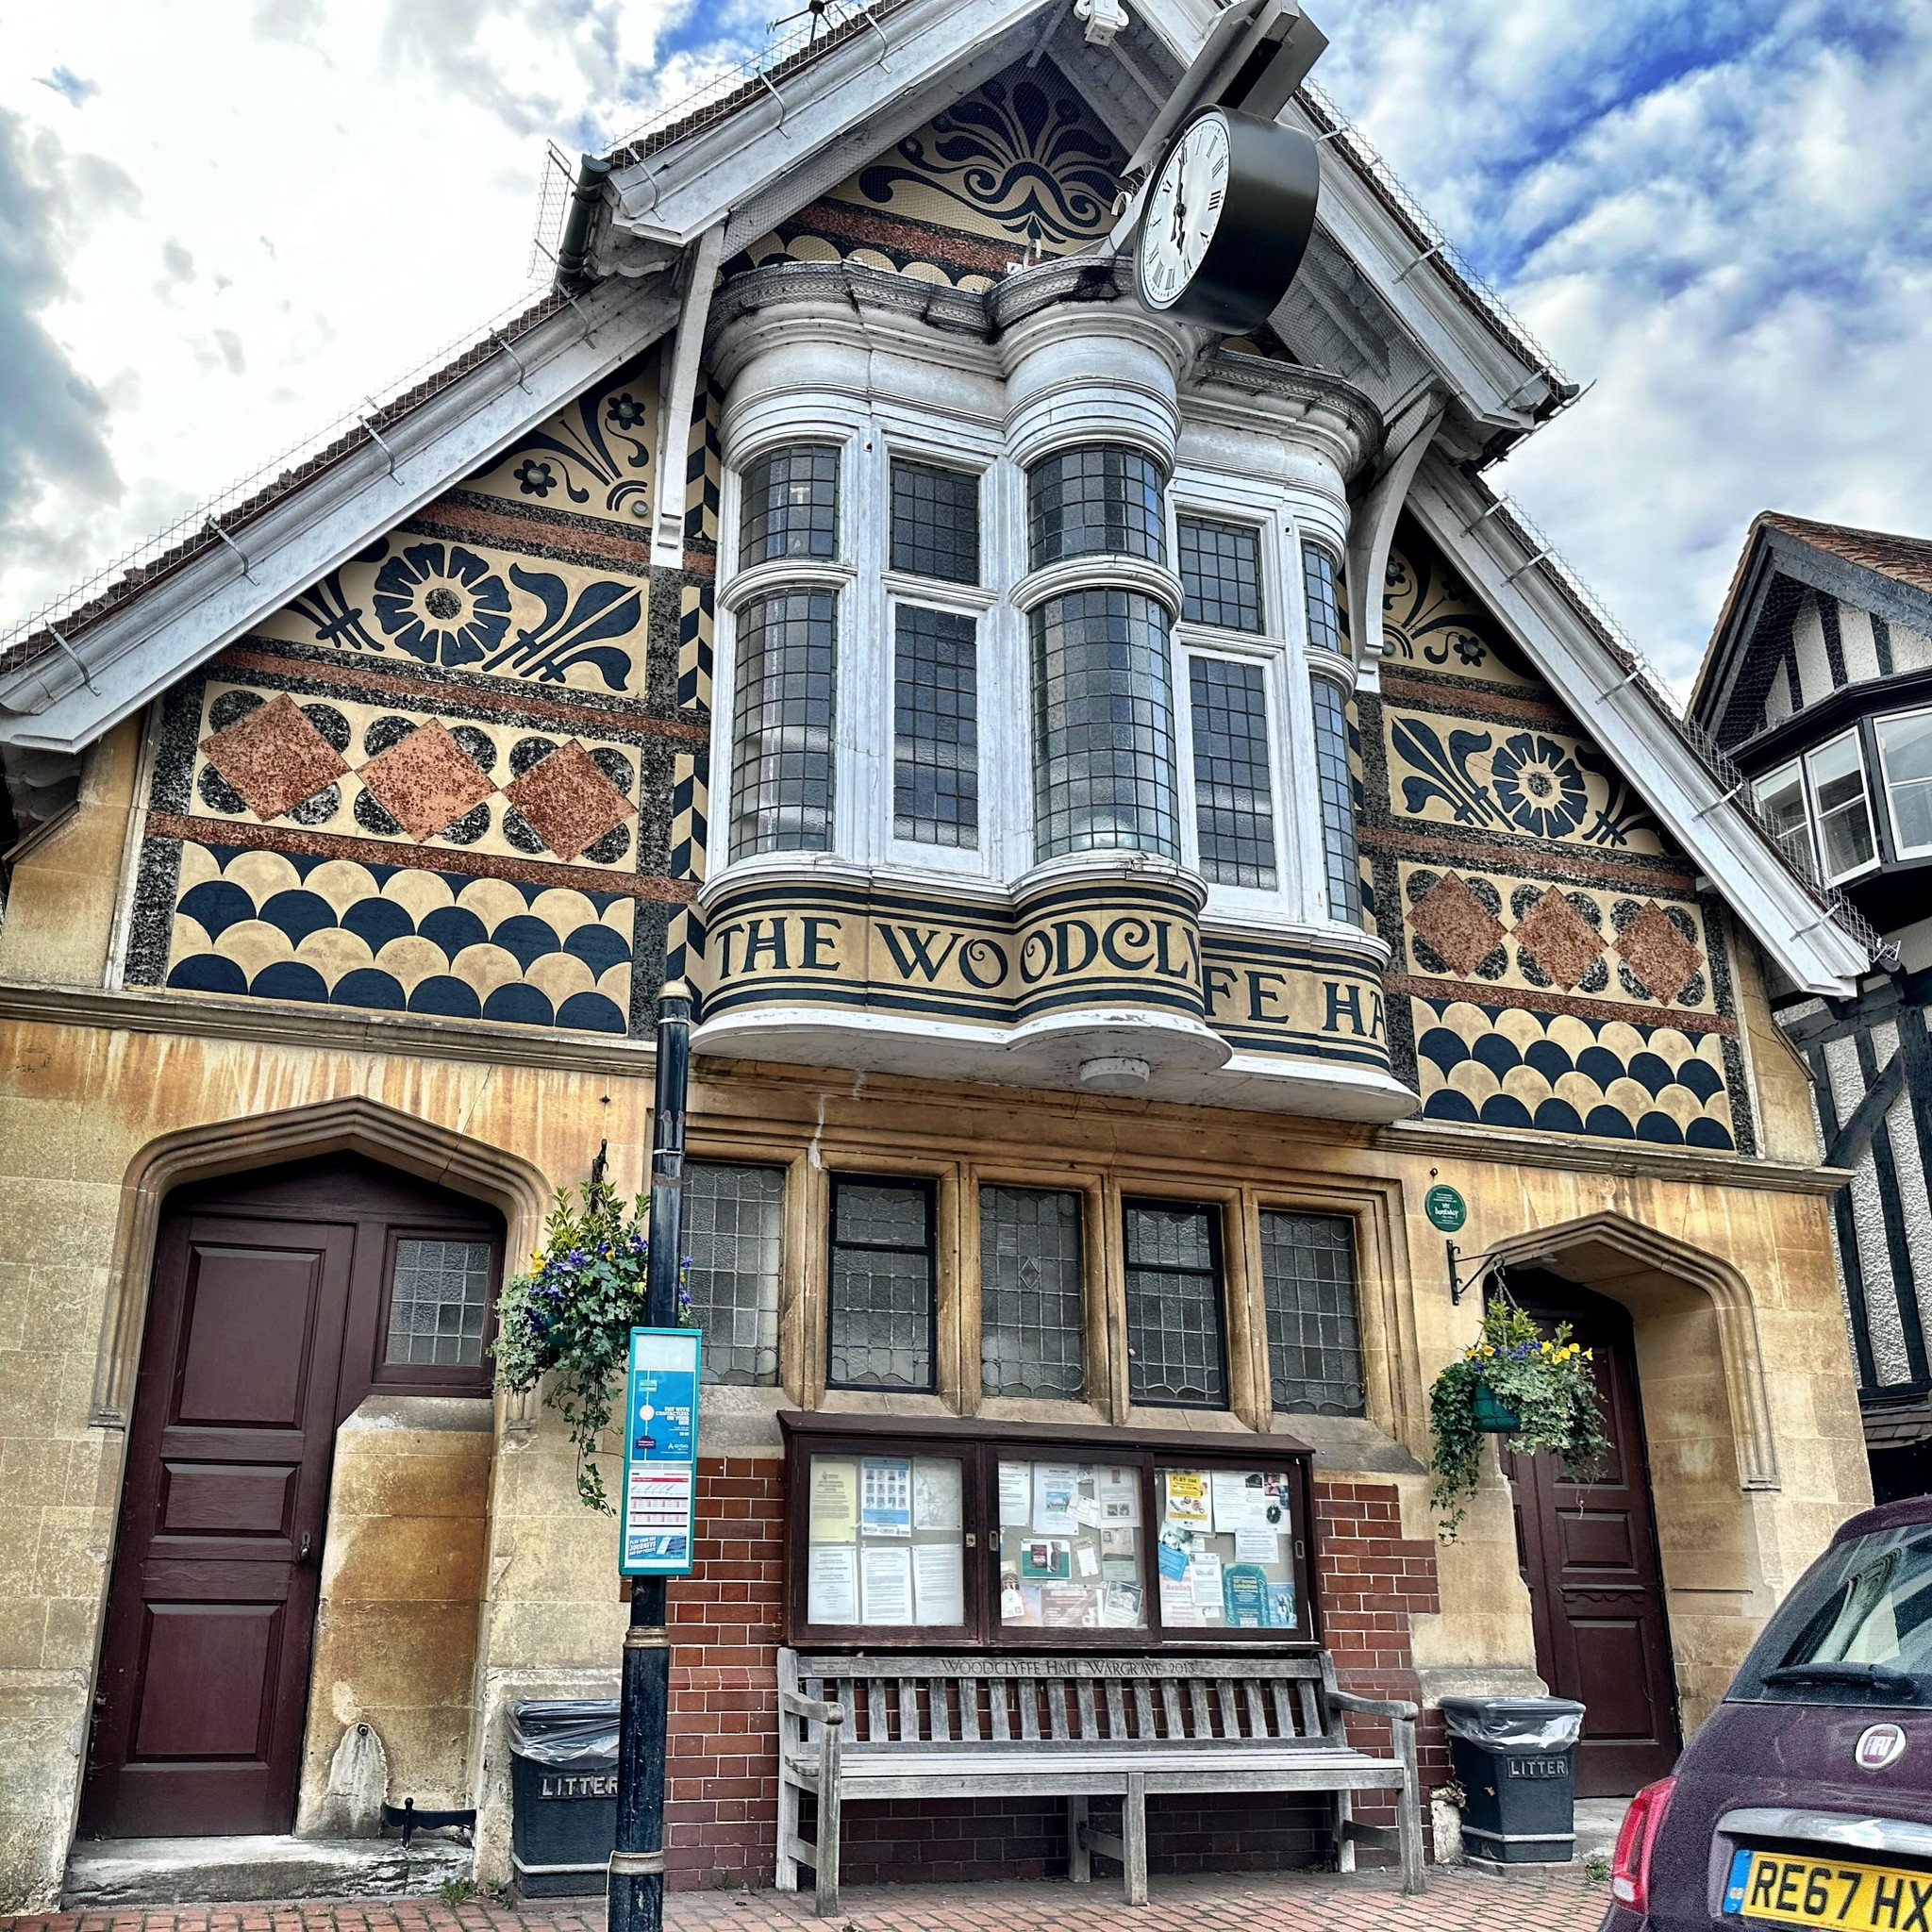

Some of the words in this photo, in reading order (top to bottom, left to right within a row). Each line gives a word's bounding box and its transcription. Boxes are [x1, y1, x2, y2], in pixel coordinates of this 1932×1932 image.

[714, 916, 842, 981] THE
[874, 917, 1290, 1024] WOODCLYFE
[941, 1659, 1040, 1675] WOODCLYFFE
[1045, 1660, 1081, 1675] HALL
[1087, 1660, 1163, 1676] WARGRAVE
[1169, 1662, 1195, 1674] 2013
[1863, 1735, 1896, 1757] FIAT
[1510, 1760, 1566, 1776] LITTER
[541, 1775, 619, 1797] LITTER
[1750, 1860, 1863, 1921] RE67
[1870, 1875, 1932, 1932] HX
